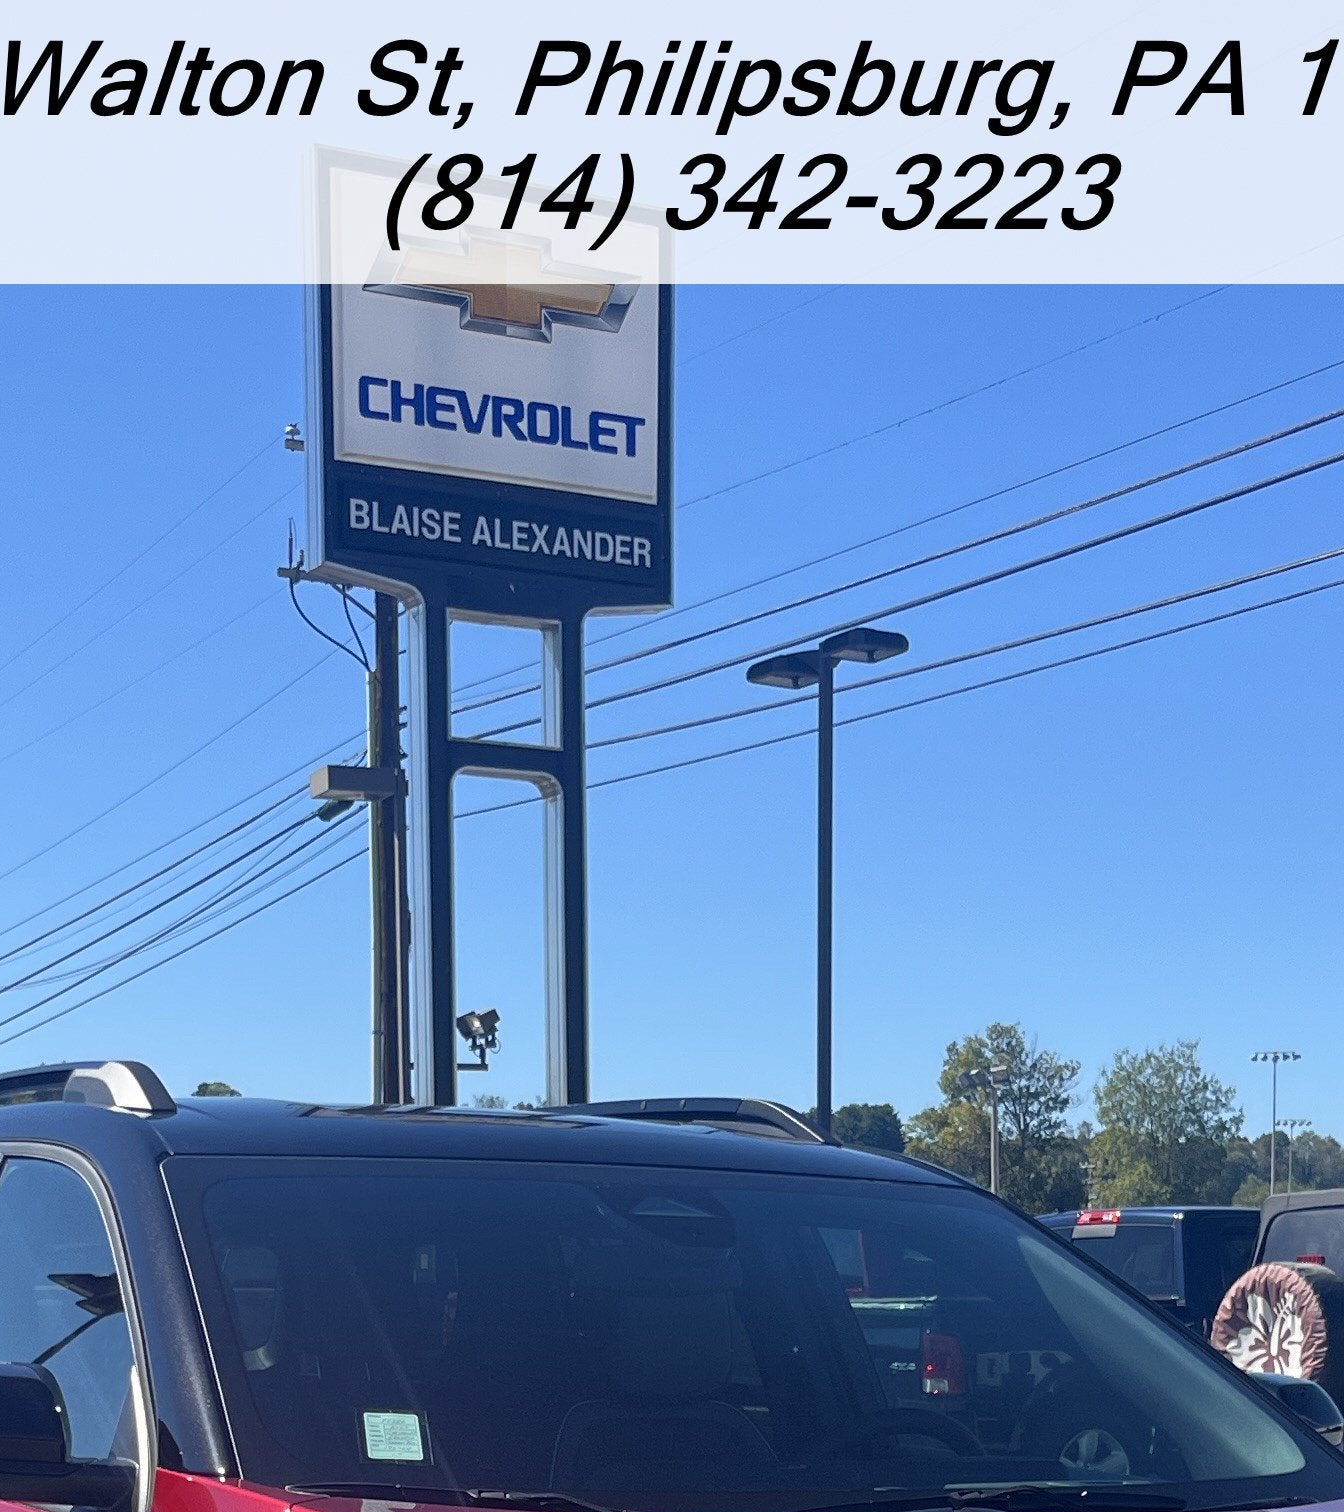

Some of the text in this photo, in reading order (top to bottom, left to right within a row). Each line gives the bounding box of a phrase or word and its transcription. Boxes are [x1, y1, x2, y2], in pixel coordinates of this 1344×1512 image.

[358, 375, 646, 457] CHEVROLET
[349, 498, 652, 568] BLAISE ALEXANDER
